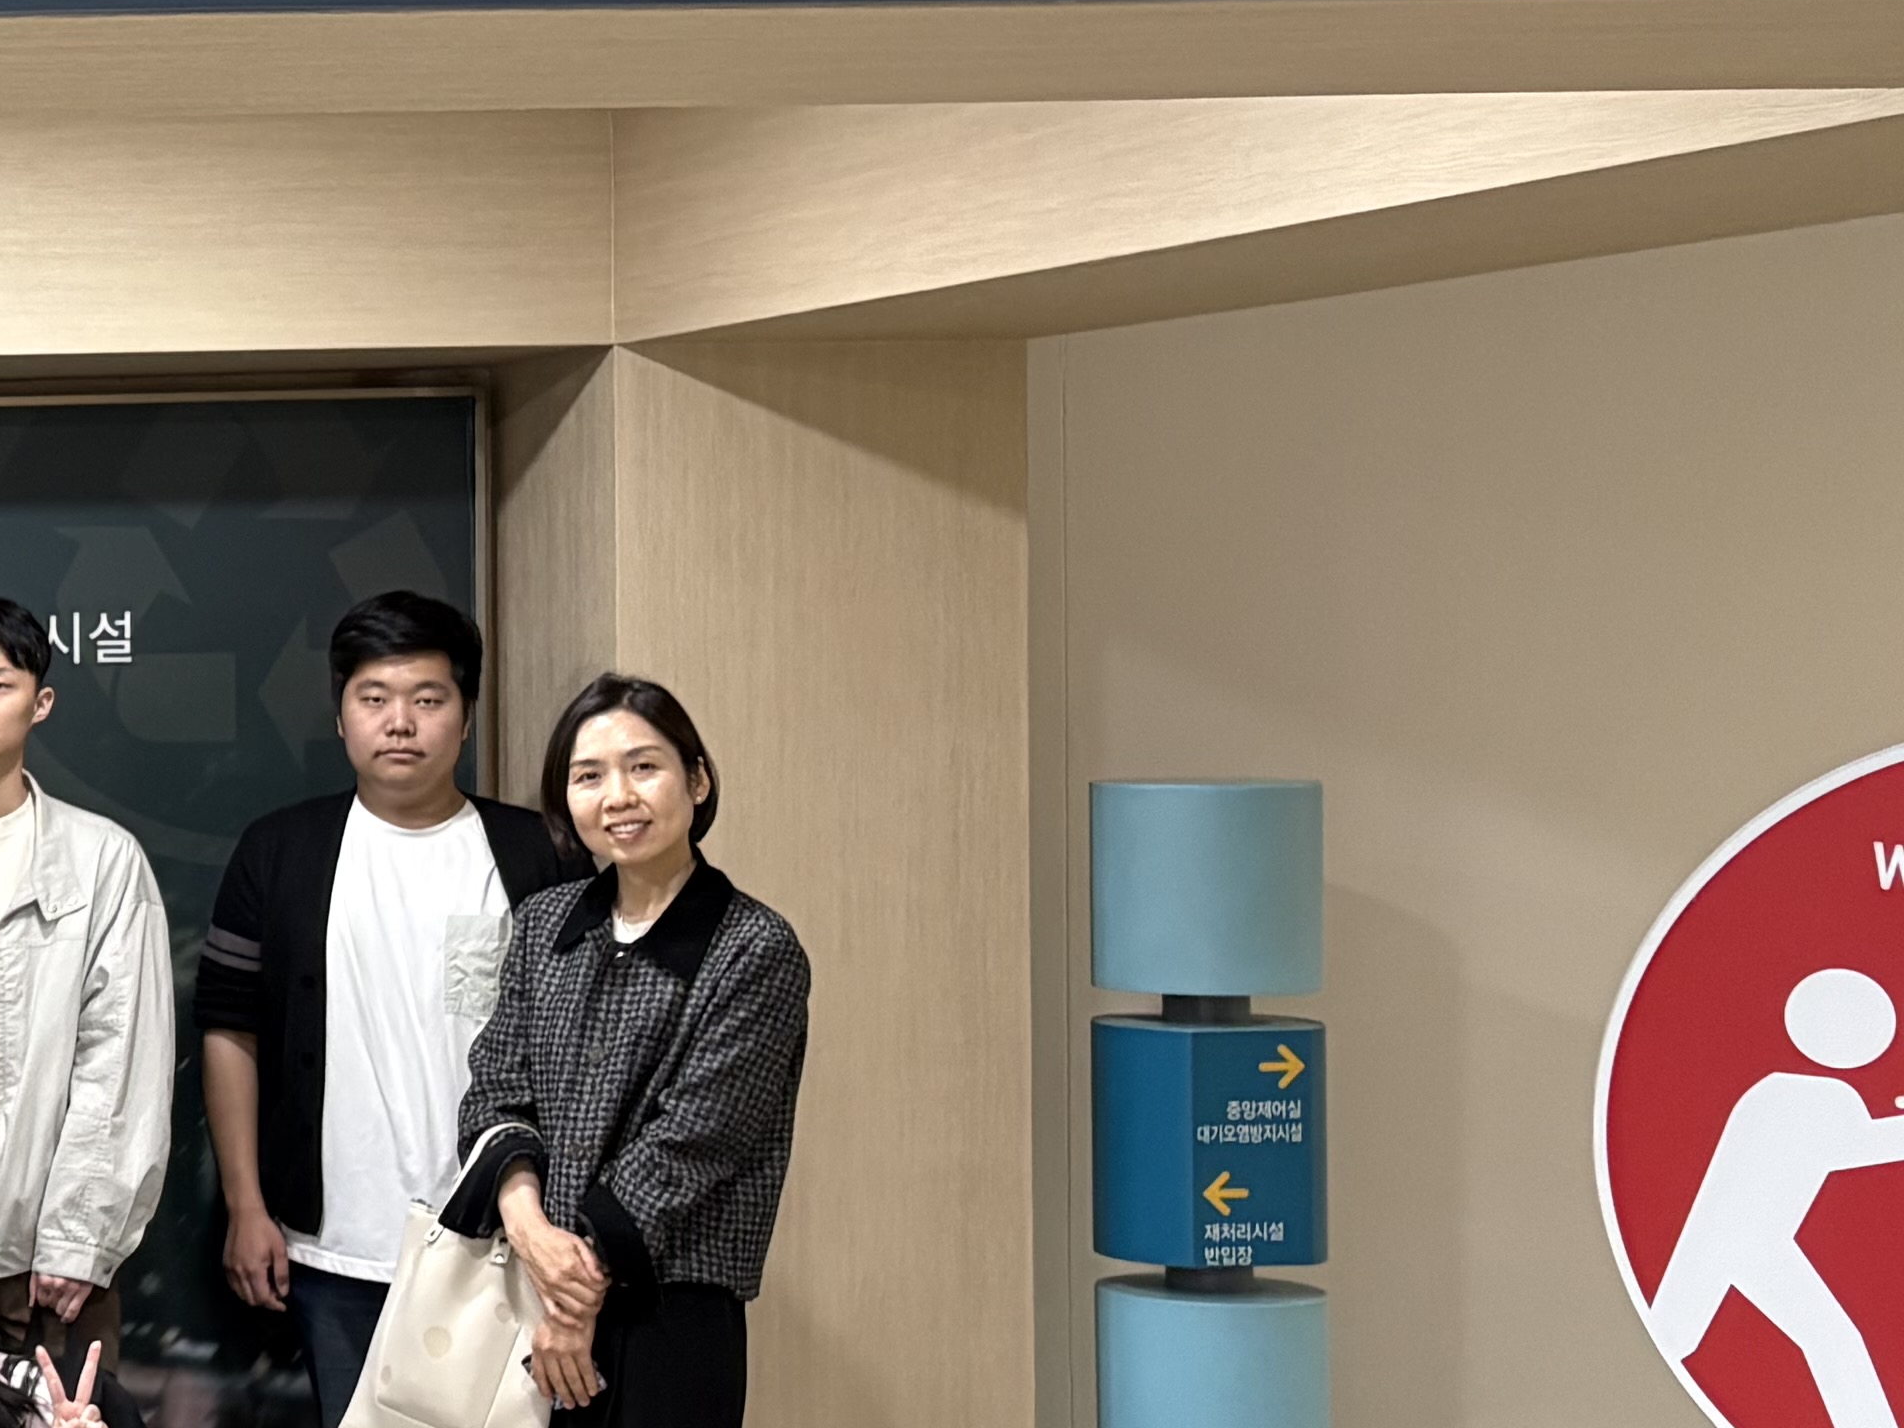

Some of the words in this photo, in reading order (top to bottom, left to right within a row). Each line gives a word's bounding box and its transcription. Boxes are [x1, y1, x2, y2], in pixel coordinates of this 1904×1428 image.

[1226, 1099, 1302, 1121] 중앙제어실
[1196, 1122, 1303, 1144] 대기오염방지시설
[1204, 1221, 1284, 1243] 재처리시설
[1204, 1245, 1253, 1267] 반입장
